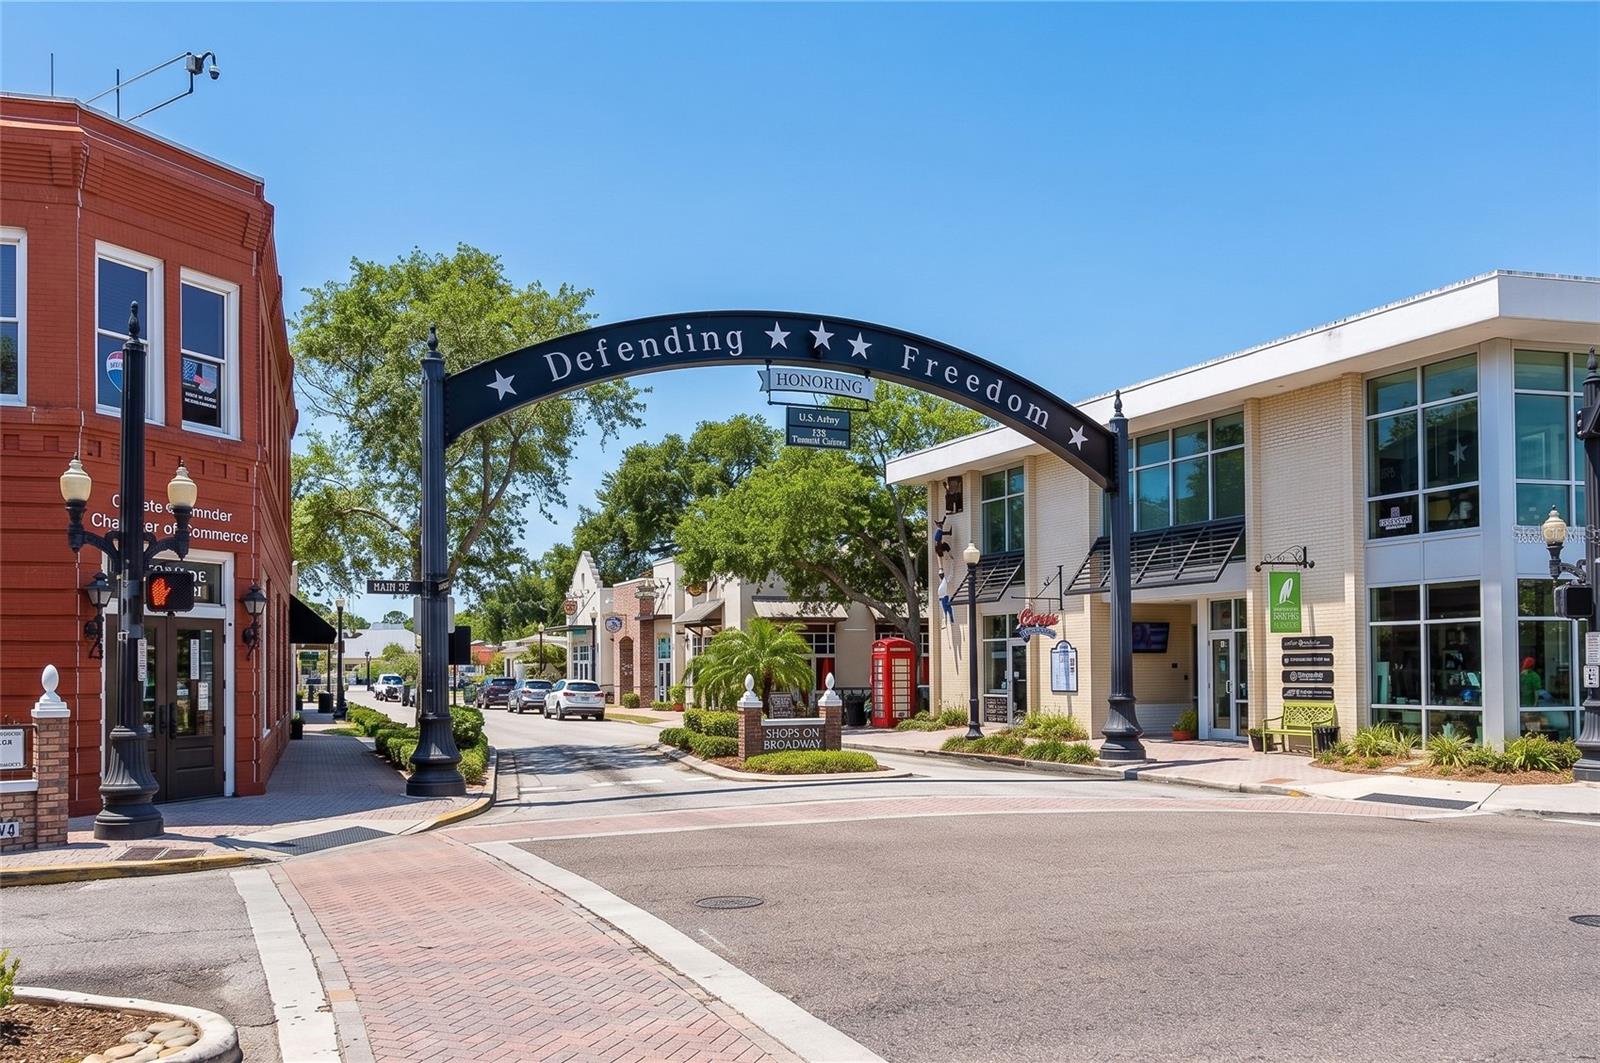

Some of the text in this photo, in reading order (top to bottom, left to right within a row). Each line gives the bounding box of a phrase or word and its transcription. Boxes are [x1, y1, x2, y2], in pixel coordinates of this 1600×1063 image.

[543, 324, 1050, 430] Defending Freedom
[776, 373, 863, 394] HONORING
[799, 413, 816, 423] U.S.
[163, 522, 178, 535] of
[373, 582, 396, 592] MAIN
[766, 728, 820, 738] SHOPS ON
[763, 739, 822, 750] BROADWAY
